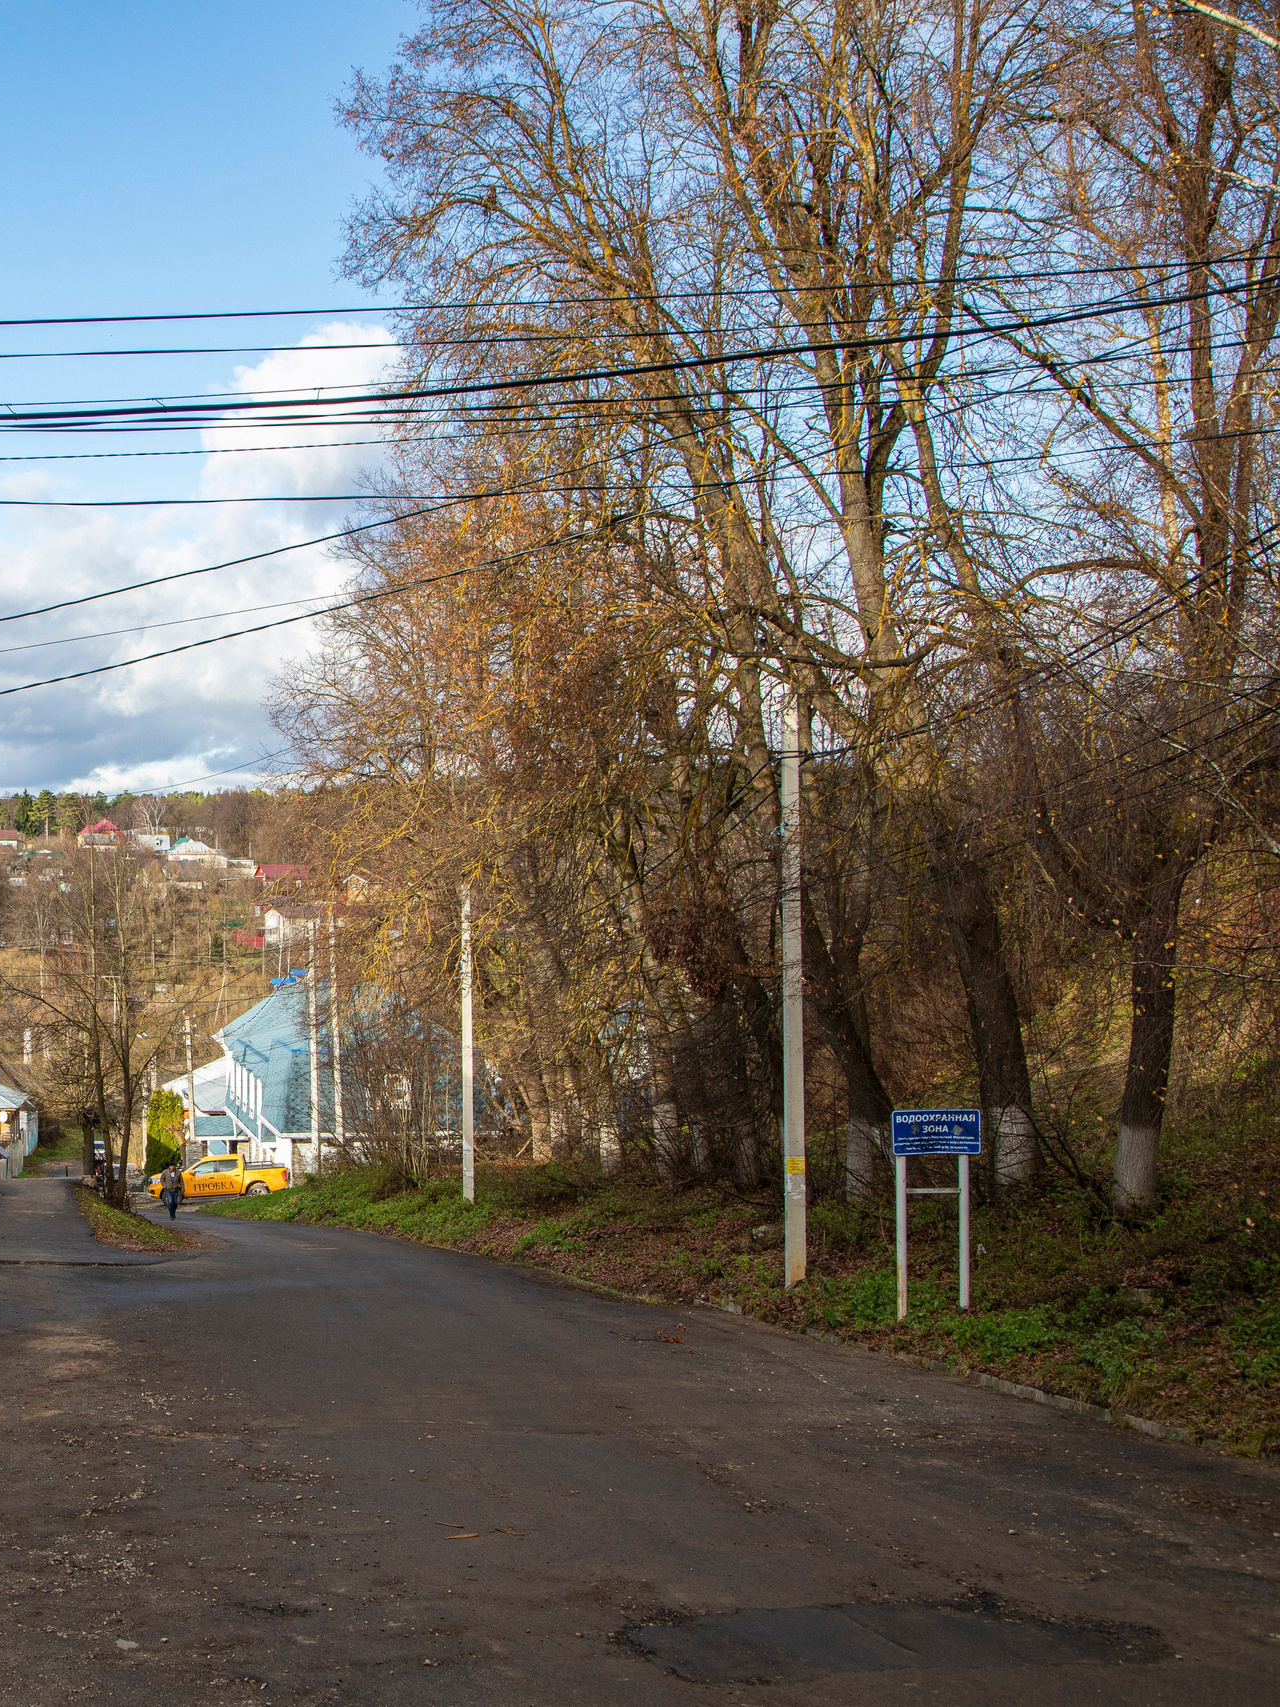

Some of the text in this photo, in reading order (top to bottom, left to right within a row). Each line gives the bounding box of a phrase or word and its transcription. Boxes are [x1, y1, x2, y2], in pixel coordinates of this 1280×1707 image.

[896, 1114, 975, 1123] ВОДООХРАННАЯ
[922, 1125, 948, 1133] ЗОНА
[194, 1182, 234, 1191] ПРОБКА
